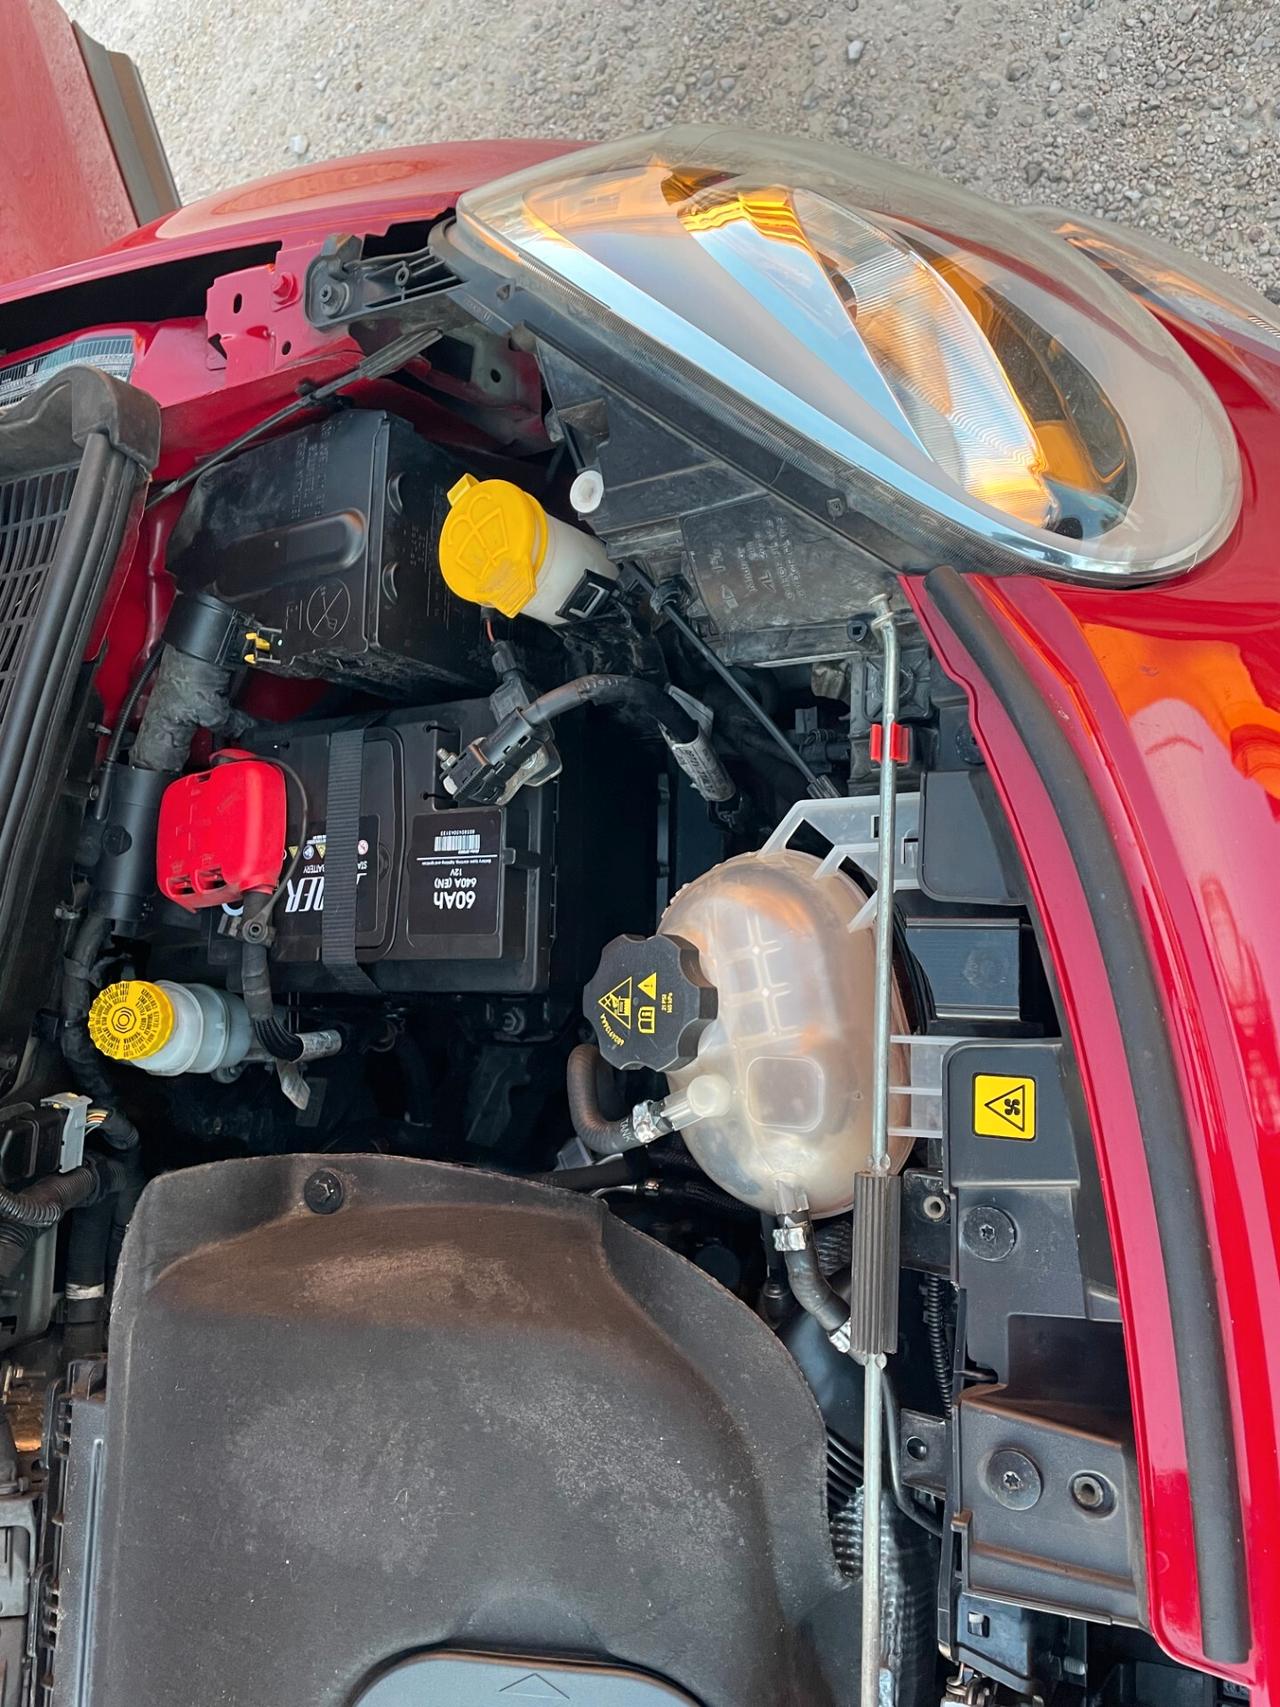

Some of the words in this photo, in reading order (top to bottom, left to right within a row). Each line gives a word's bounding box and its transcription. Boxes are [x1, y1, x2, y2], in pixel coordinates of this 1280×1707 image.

[449, 868, 462, 876] 12V
[434, 877, 453, 889] (EN)
[454, 877, 477, 888] 640A
[433, 890, 476, 909] 60Ah
